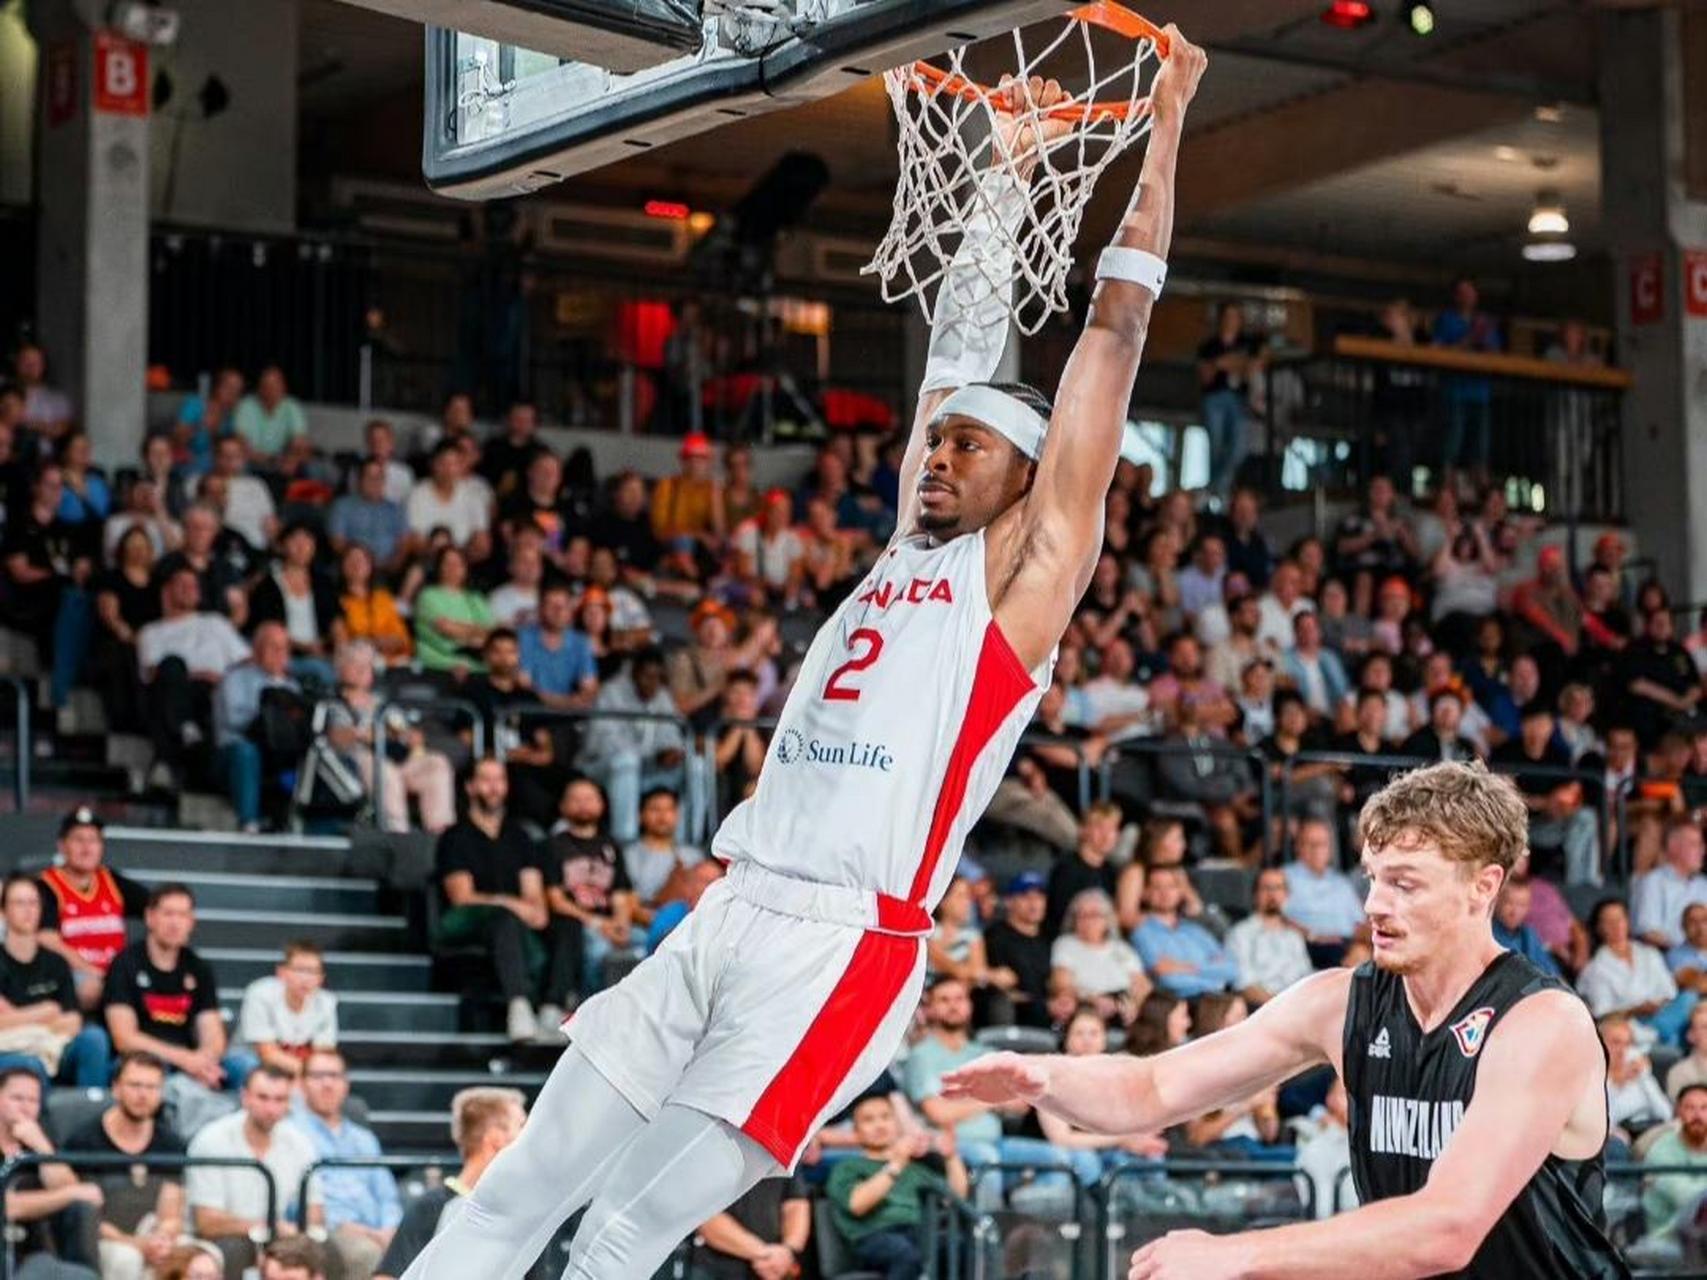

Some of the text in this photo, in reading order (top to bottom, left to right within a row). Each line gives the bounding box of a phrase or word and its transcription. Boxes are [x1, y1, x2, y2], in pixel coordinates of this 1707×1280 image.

[105, 53, 137, 95] B
[823, 628, 883, 700] 2
[806, 739, 893, 772] Sun Life
